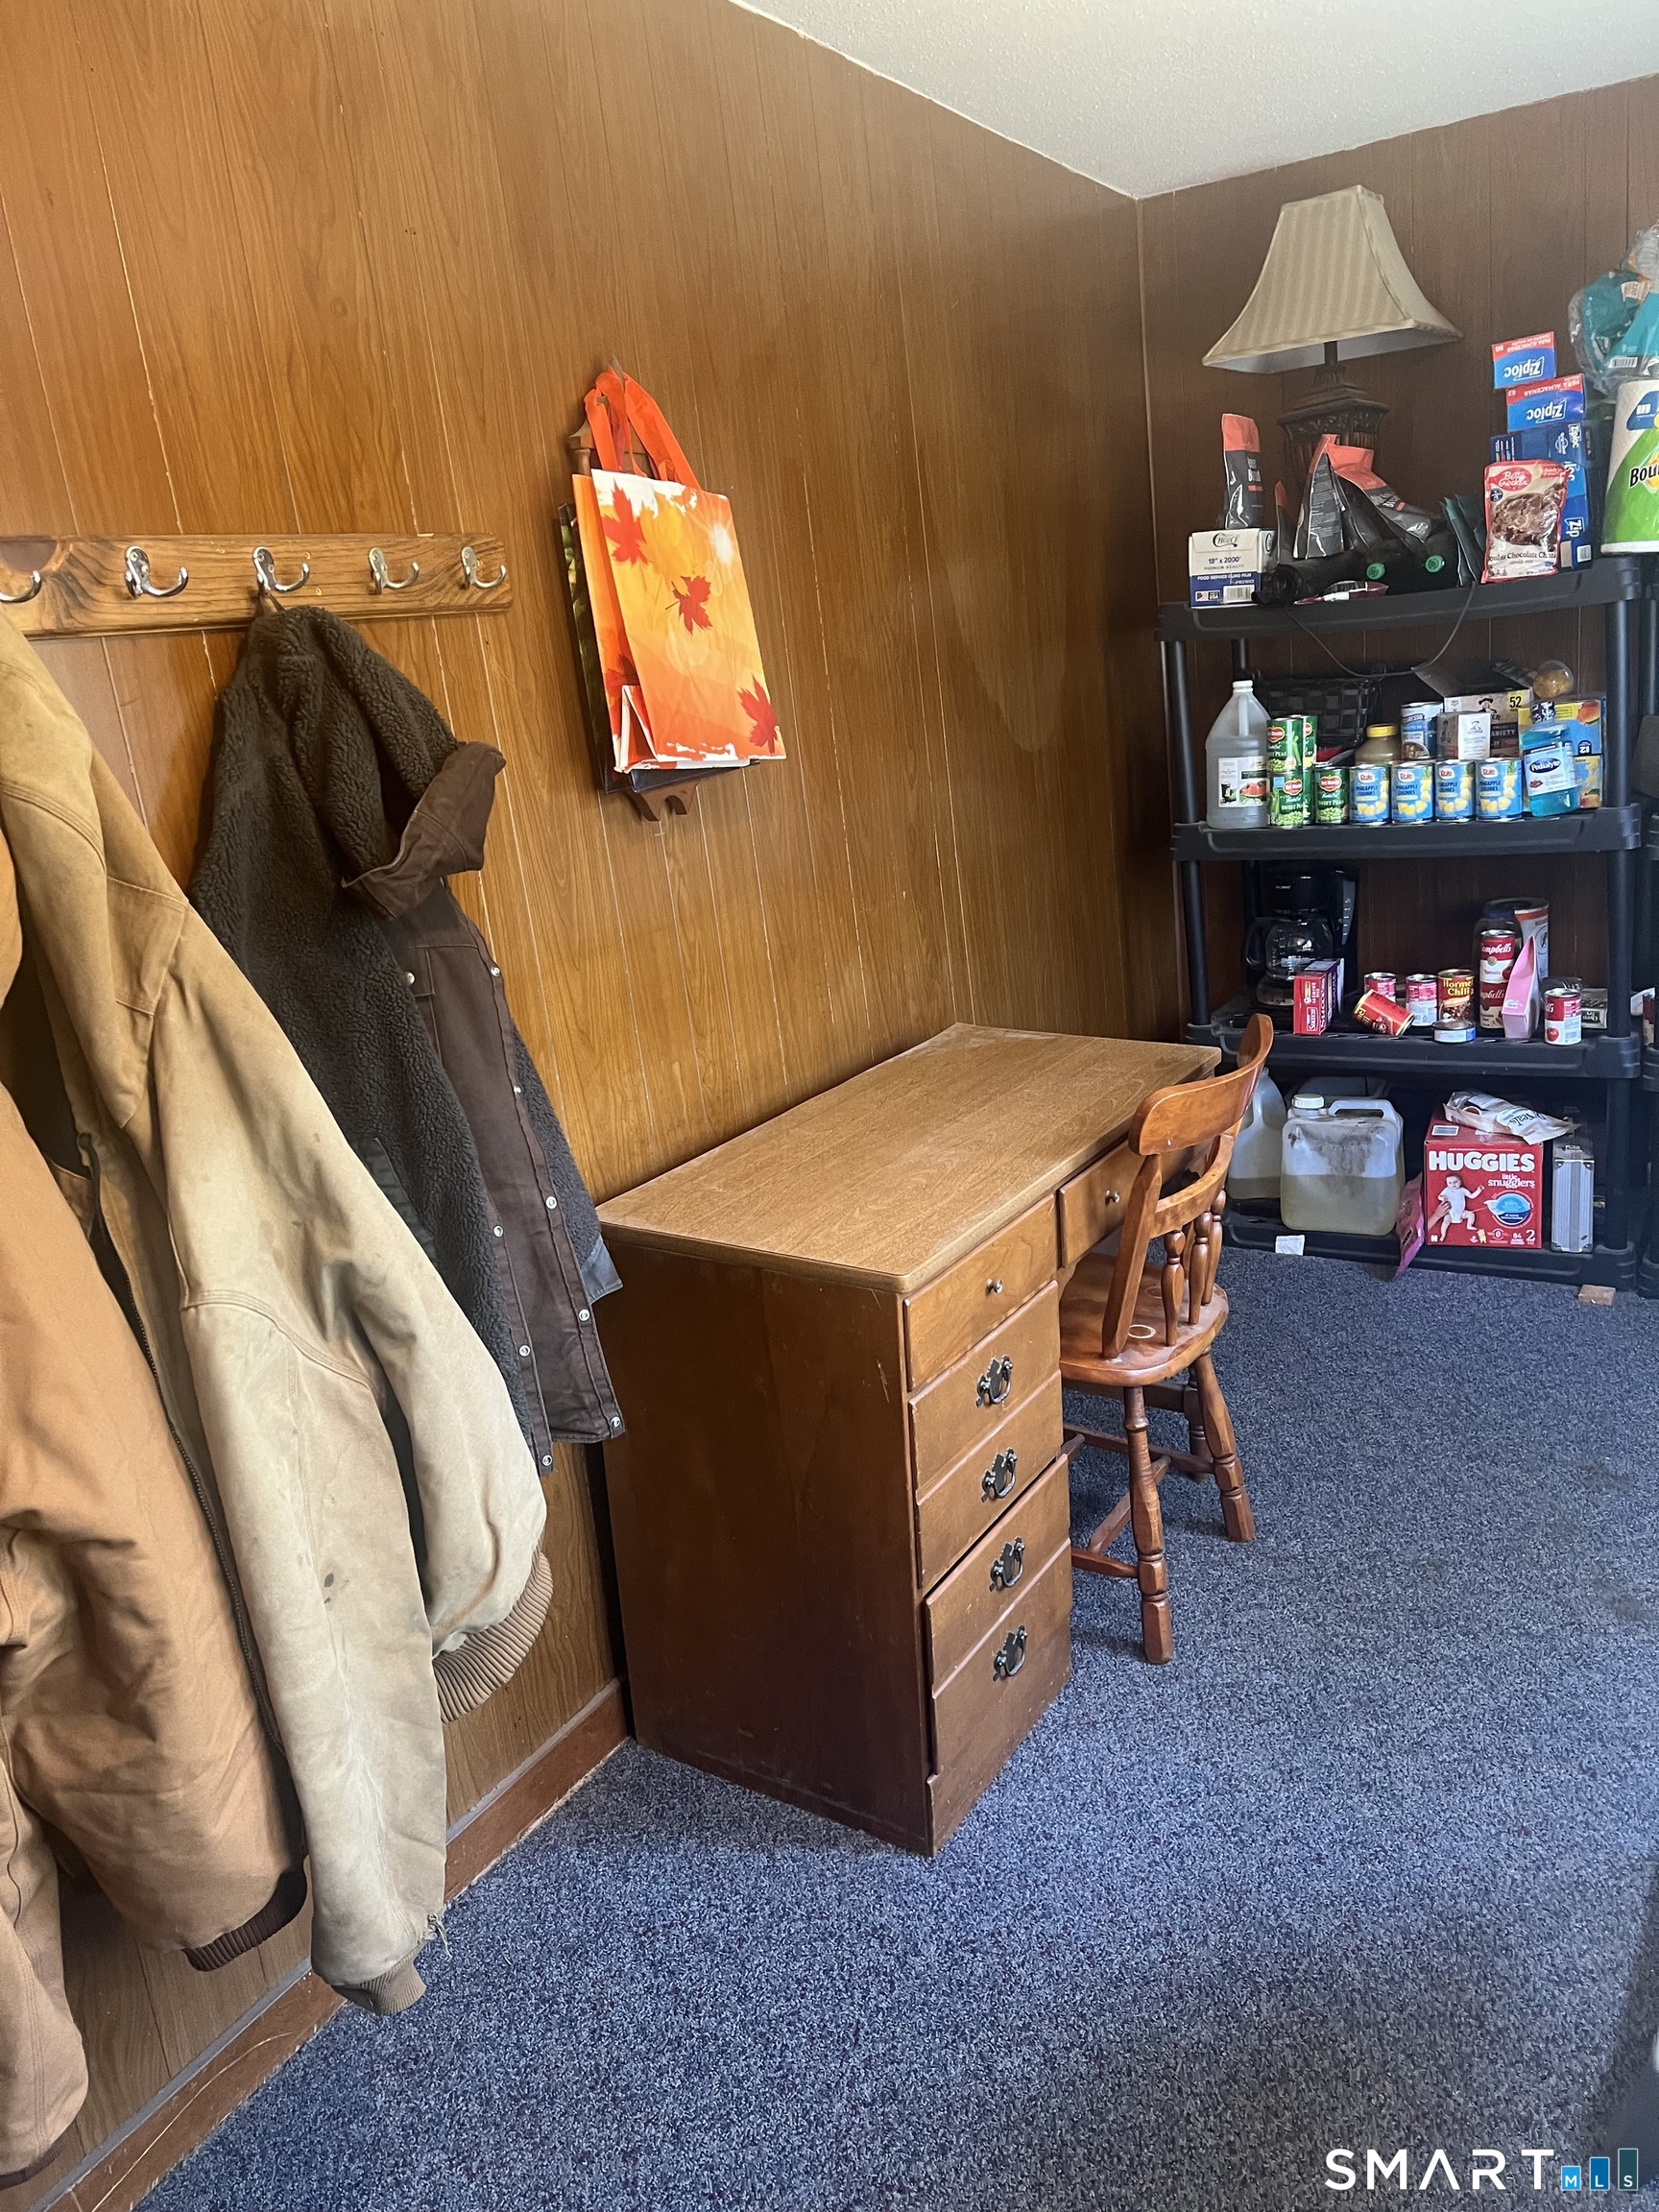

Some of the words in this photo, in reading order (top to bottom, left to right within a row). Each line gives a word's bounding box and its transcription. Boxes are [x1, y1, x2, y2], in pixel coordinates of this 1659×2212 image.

[1503, 359, 1541, 377] Ziploc
[1527, 402, 1564, 421] Ziploc
[1569, 425, 1580, 448] Ziploc
[1503, 470, 1527, 480] Betty
[1629, 465, 1659, 488] Bou
[1509, 696, 1521, 709] 52
[1531, 760, 1561, 772] Pedialyte
[1444, 979, 1473, 988] Hormel
[1448, 987, 1469, 996] Chili
[1429, 1151, 1535, 1172] HUGGIES
[1488, 1178, 1536, 1189] snugglers
[1526, 1229, 1536, 1240] 2
